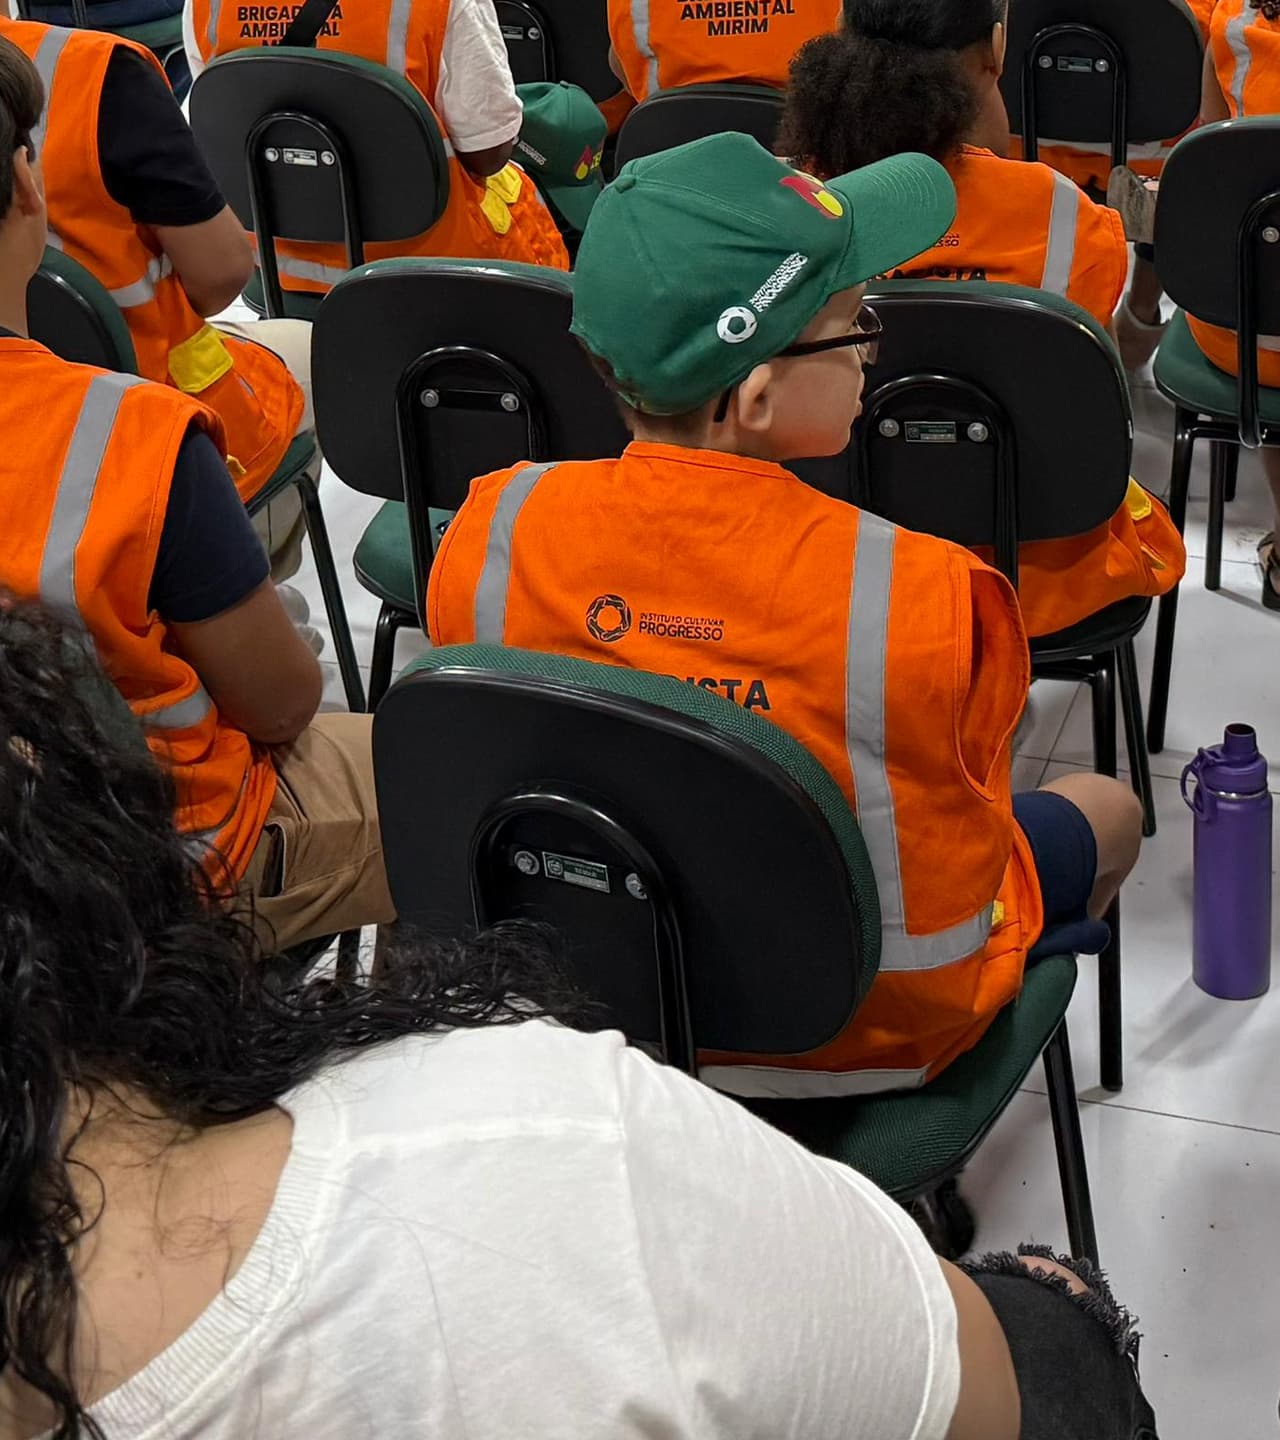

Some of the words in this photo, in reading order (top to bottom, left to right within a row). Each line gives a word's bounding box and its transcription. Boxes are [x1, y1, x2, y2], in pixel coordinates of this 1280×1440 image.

[238, 4, 343, 21] BRIGADA
[240, 22, 340, 38] AMBIAL
[708, 18, 768, 36] MIRIM
[640, 612, 683, 624] INSTITUTO
[639, 621, 723, 641] PROGRESSO
